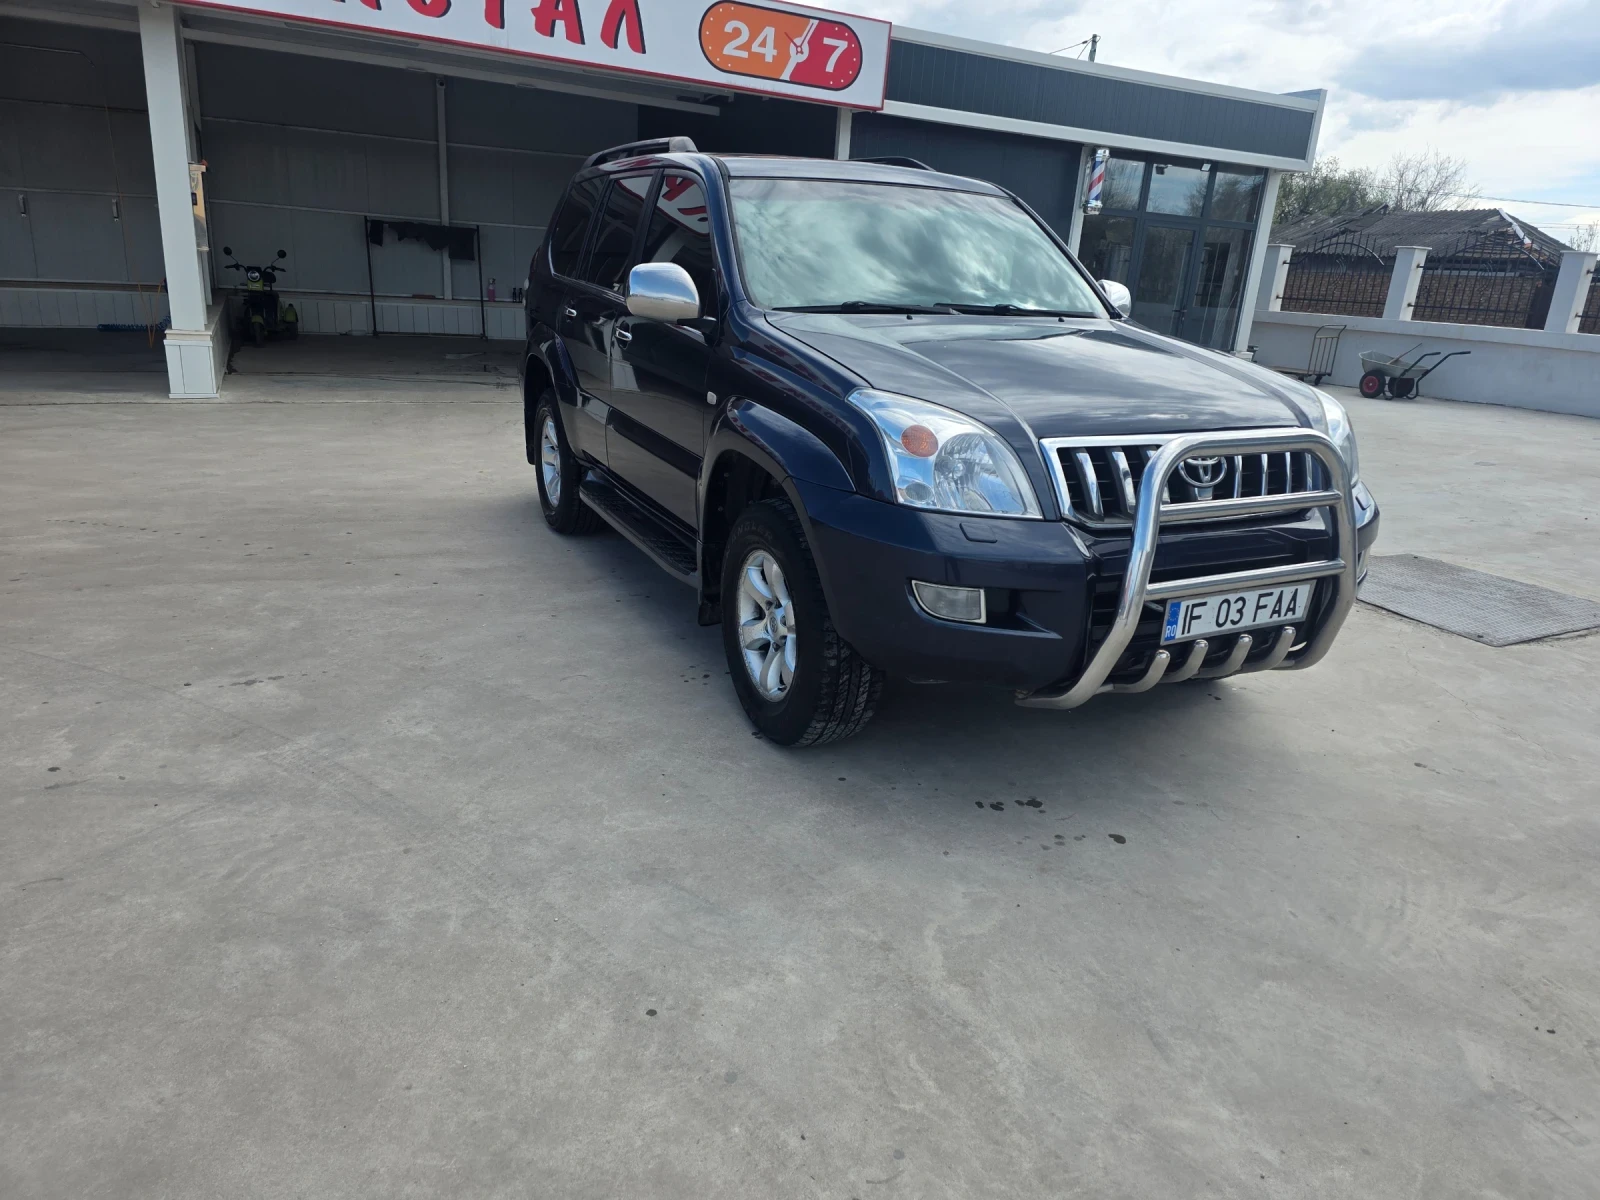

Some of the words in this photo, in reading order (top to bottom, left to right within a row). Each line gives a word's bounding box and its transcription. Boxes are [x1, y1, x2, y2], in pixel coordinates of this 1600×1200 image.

[722, 20, 777, 63] 24
[823, 37, 849, 73] 7
[1165, 625, 1177, 638] RO
[1181, 601, 1207, 635] IF
[1215, 596, 1247, 628] 03
[1252, 588, 1299, 622] FAA
